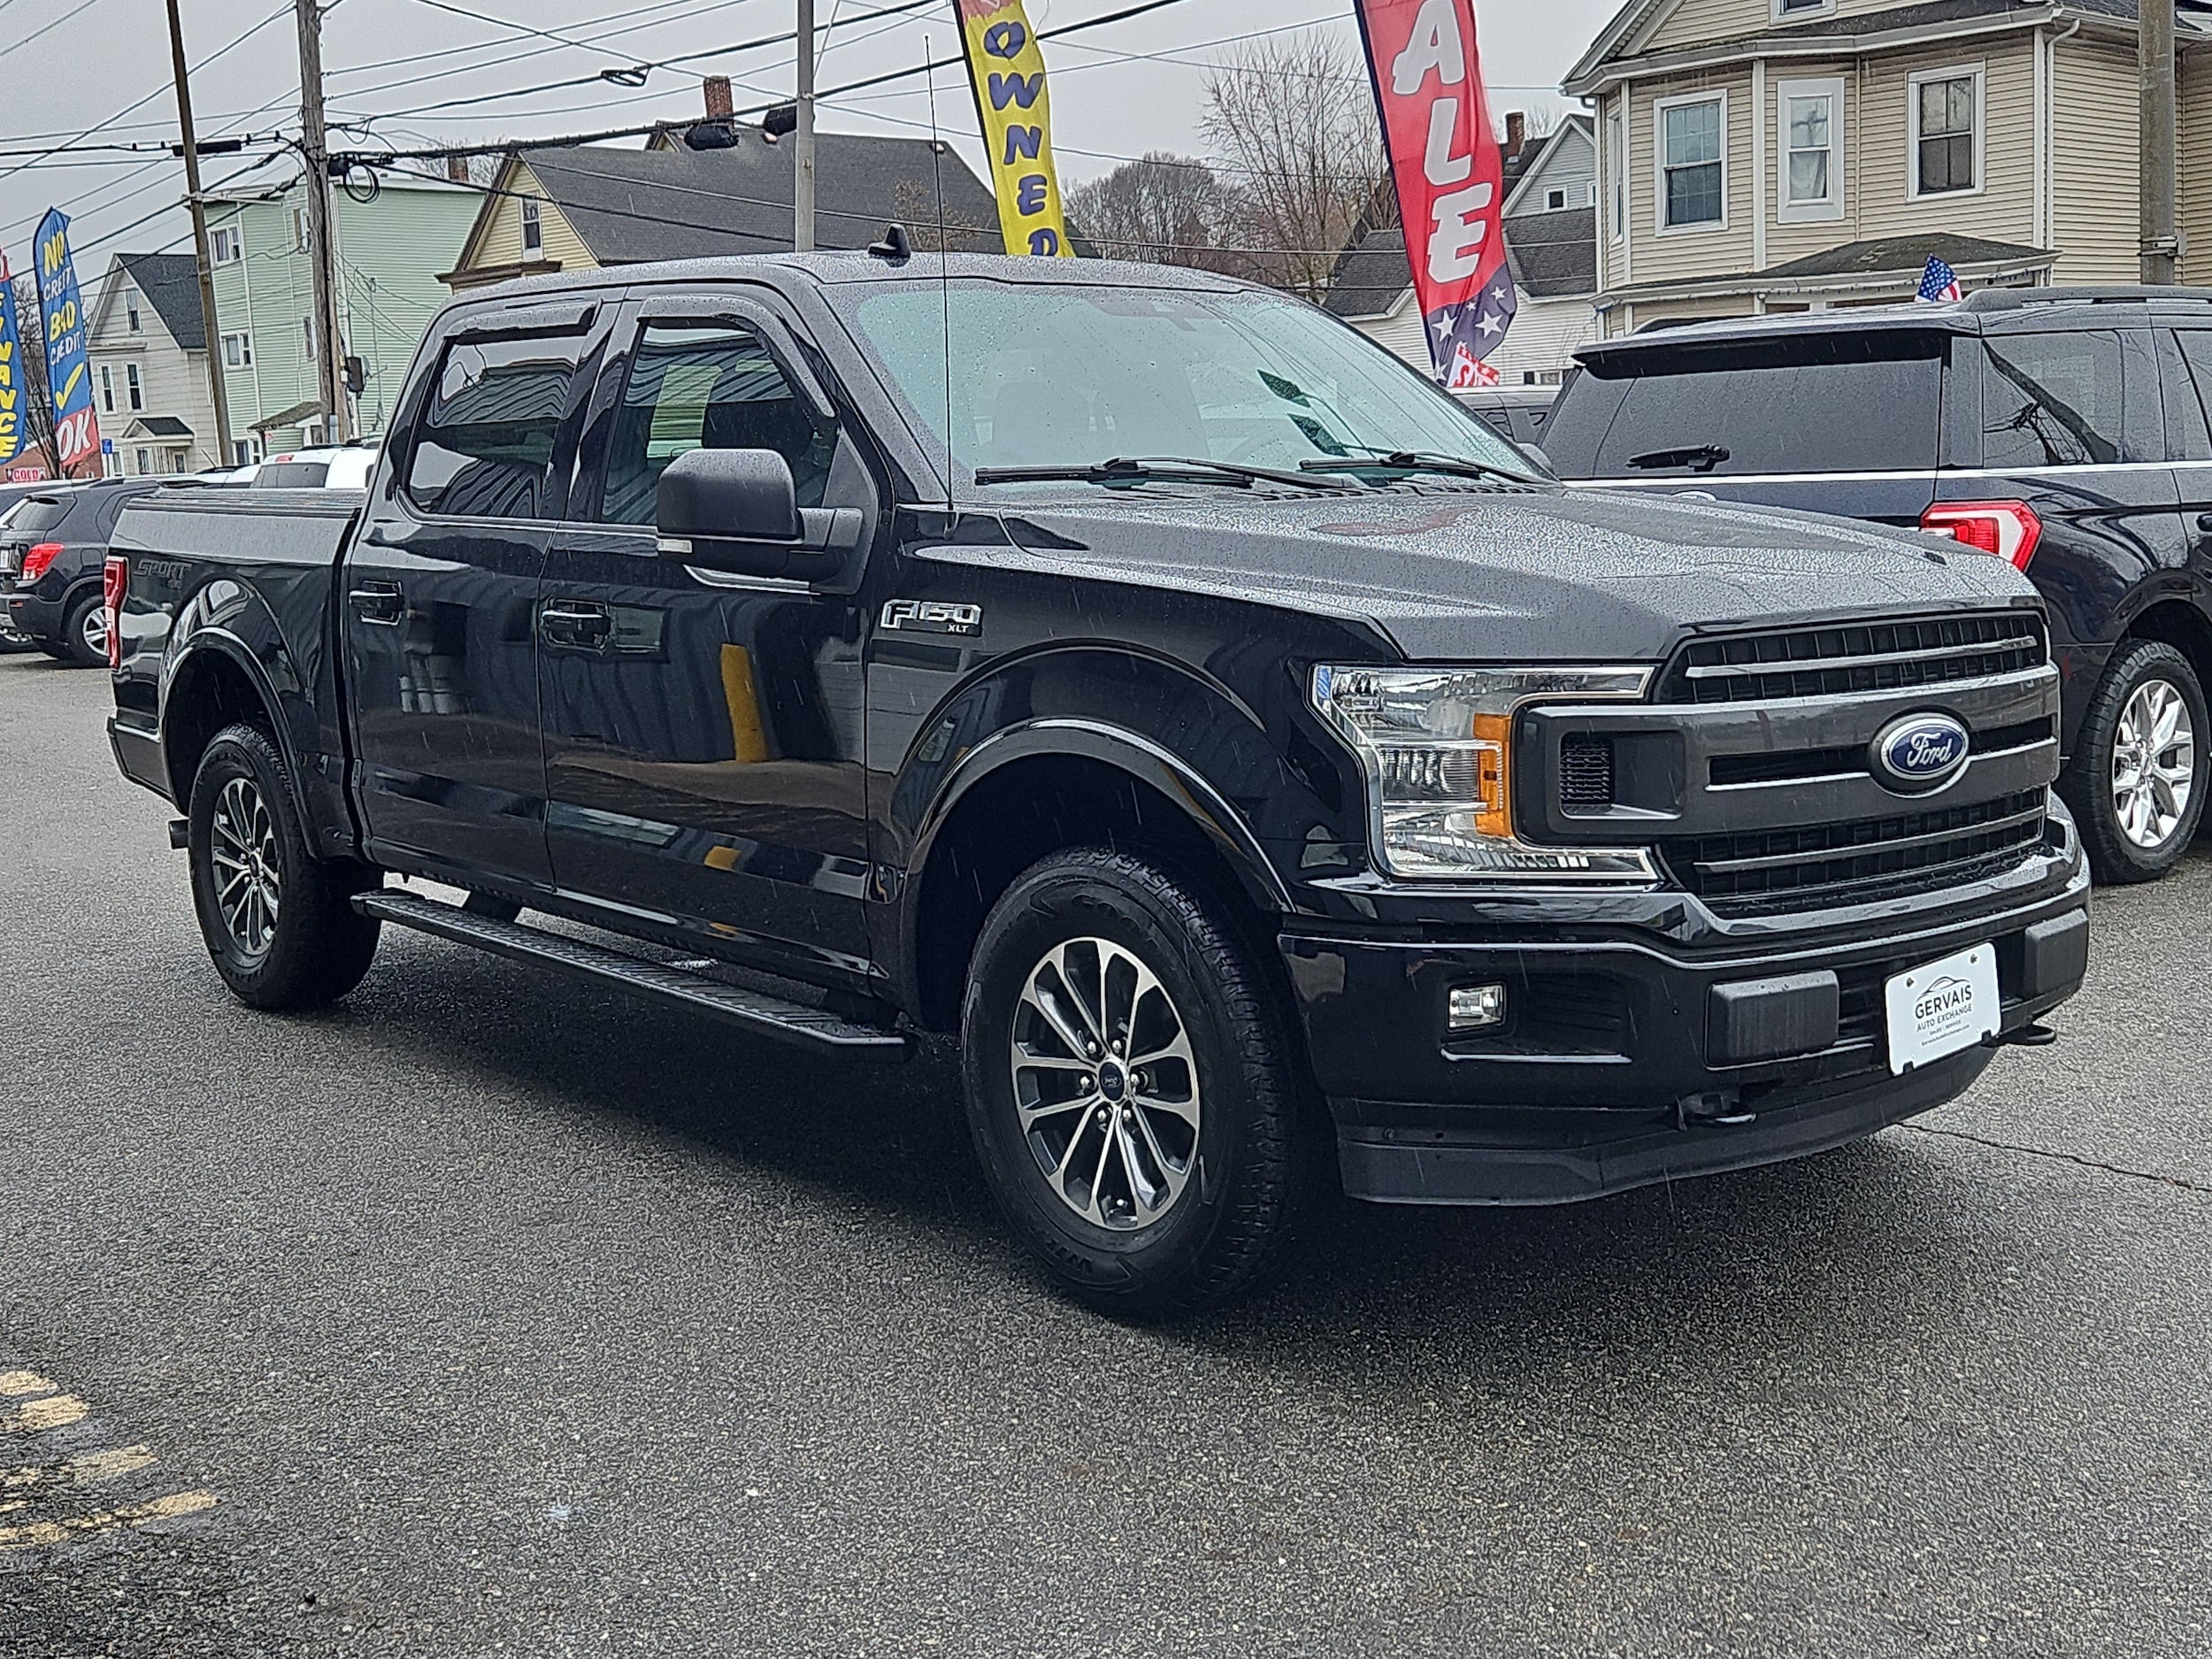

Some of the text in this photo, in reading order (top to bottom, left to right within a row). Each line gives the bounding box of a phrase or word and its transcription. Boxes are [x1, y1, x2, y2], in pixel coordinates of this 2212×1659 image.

[983, 21, 1058, 256] OWNED
[43, 230, 65, 278] NO
[50, 300, 76, 342] BAD
[57, 410, 91, 462] OK
[134, 559, 193, 579] SPORT
[947, 624, 970, 634] XLT
[1907, 733, 1952, 767] Ford
[1915, 985, 1972, 1019] GERVAIS
[1916, 1003, 1973, 1033] AUTO EXCHANGE
